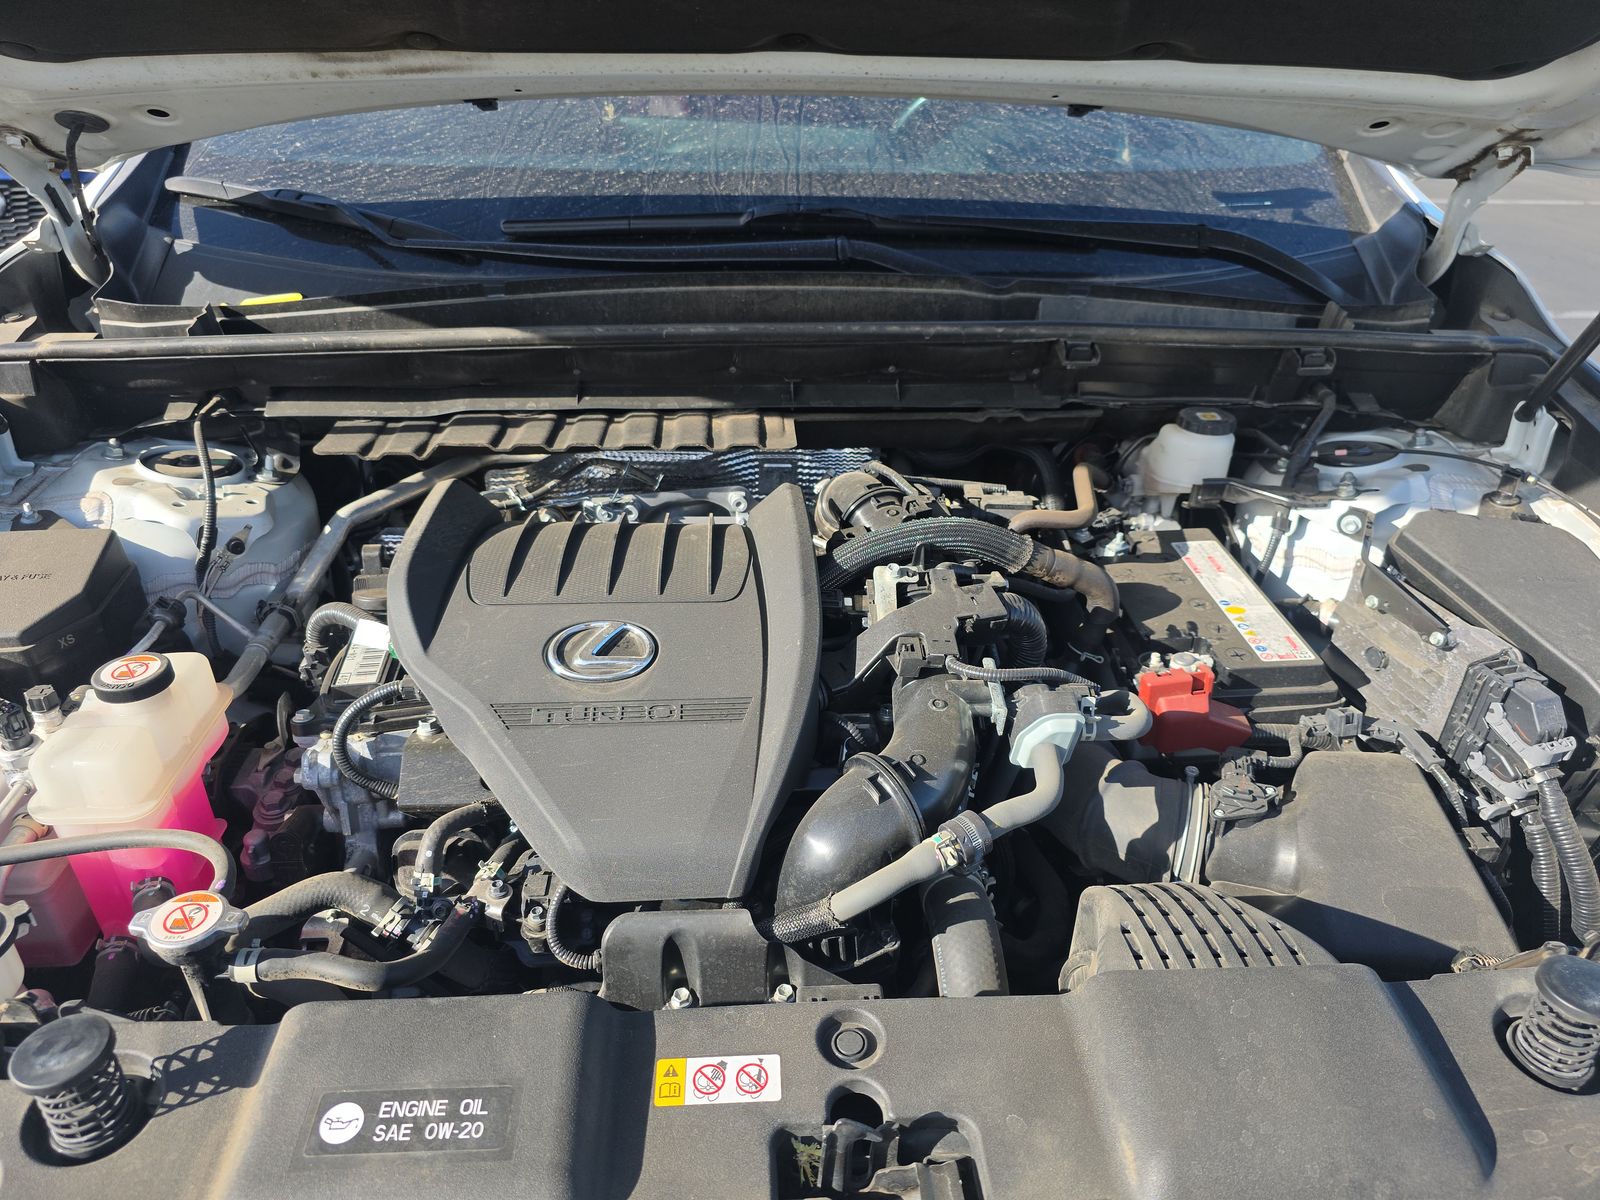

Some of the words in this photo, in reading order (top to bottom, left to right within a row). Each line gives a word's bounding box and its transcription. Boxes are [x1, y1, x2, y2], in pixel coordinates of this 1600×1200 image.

[57, 634, 76, 649] XS
[536, 703, 677, 723] TURBO
[378, 1099, 448, 1118] ENGINE
[460, 1098, 488, 1116] OIL
[372, 1123, 413, 1142] SAE
[425, 1121, 484, 1140] 0W-20
